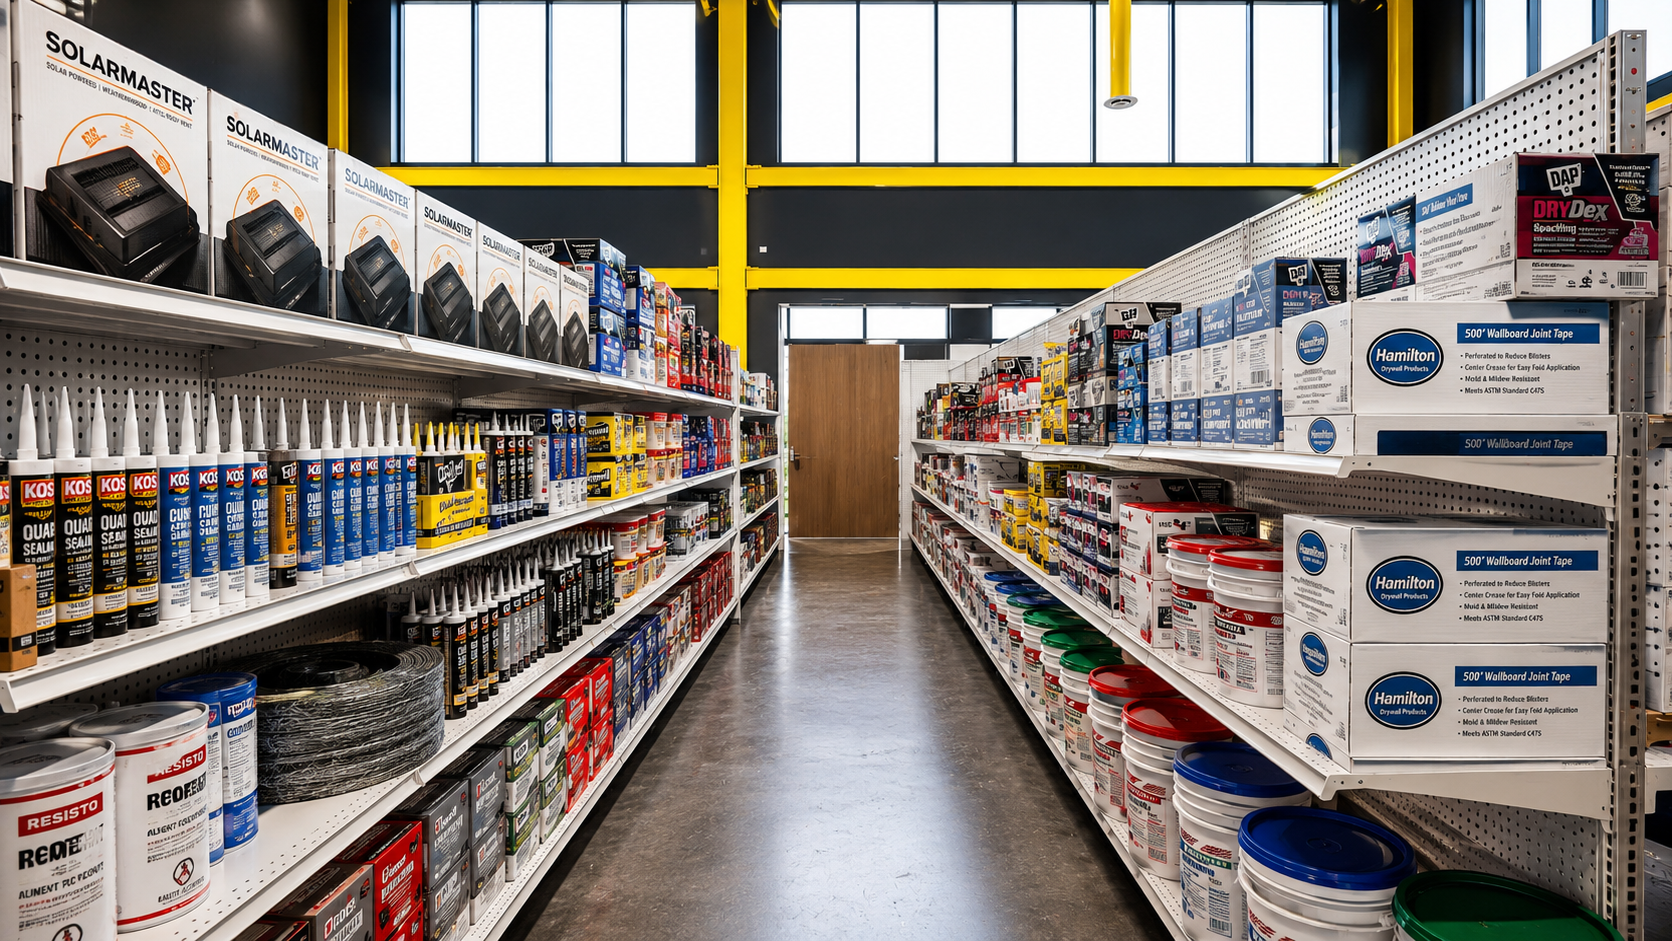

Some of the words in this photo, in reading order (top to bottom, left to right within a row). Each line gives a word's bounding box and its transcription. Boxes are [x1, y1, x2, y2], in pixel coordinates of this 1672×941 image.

[46, 30, 193, 115] SOLARMASTER
[226, 115, 319, 171] SOLARMASTER
[1550, 167, 1579, 187] DAP
[345, 167, 409, 209] SOLARMASTER
[1533, 199, 1609, 221] DRYDex
[1465, 329, 1485, 338] 500'
[1487, 329, 1529, 338] Wallboard
[1530, 329, 1552, 338] Joint
[1553, 329, 1573, 341] Tape
[1376, 348, 1435, 362] Hamilton
[1517, 364, 1531, 372] Easy
[1546, 364, 1580, 372] Application
[1465, 439, 1485, 448] 500'
[1487, 439, 1529, 448] Wallboard
[1530, 439, 1551, 448] Joint
[1553, 439, 1573, 451] Tape
[64, 479, 92, 496] KOS
[101, 477, 126, 492] KOS
[134, 475, 157, 490] KOS
[170, 473, 190, 487] KOS
[24, 482, 54, 499] KOS
[1464, 556, 1485, 566] 500'
[1486, 556, 1528, 566] Wallboard
[1529, 556, 1551, 566] Joint
[1553, 556, 1573, 568] Tape
[1375, 575, 1435, 590] Hamilton
[1463, 671, 1483, 681] 500'
[1485, 671, 1527, 681] Wallboard
[1528, 671, 1550, 681] Joint
[1551, 671, 1571, 684] Tape
[1374, 691, 1433, 705] Hamilton
[1515, 707, 1528, 715] Easy
[1544, 707, 1578, 715] Application
[27, 800, 98, 831] RESISTO
